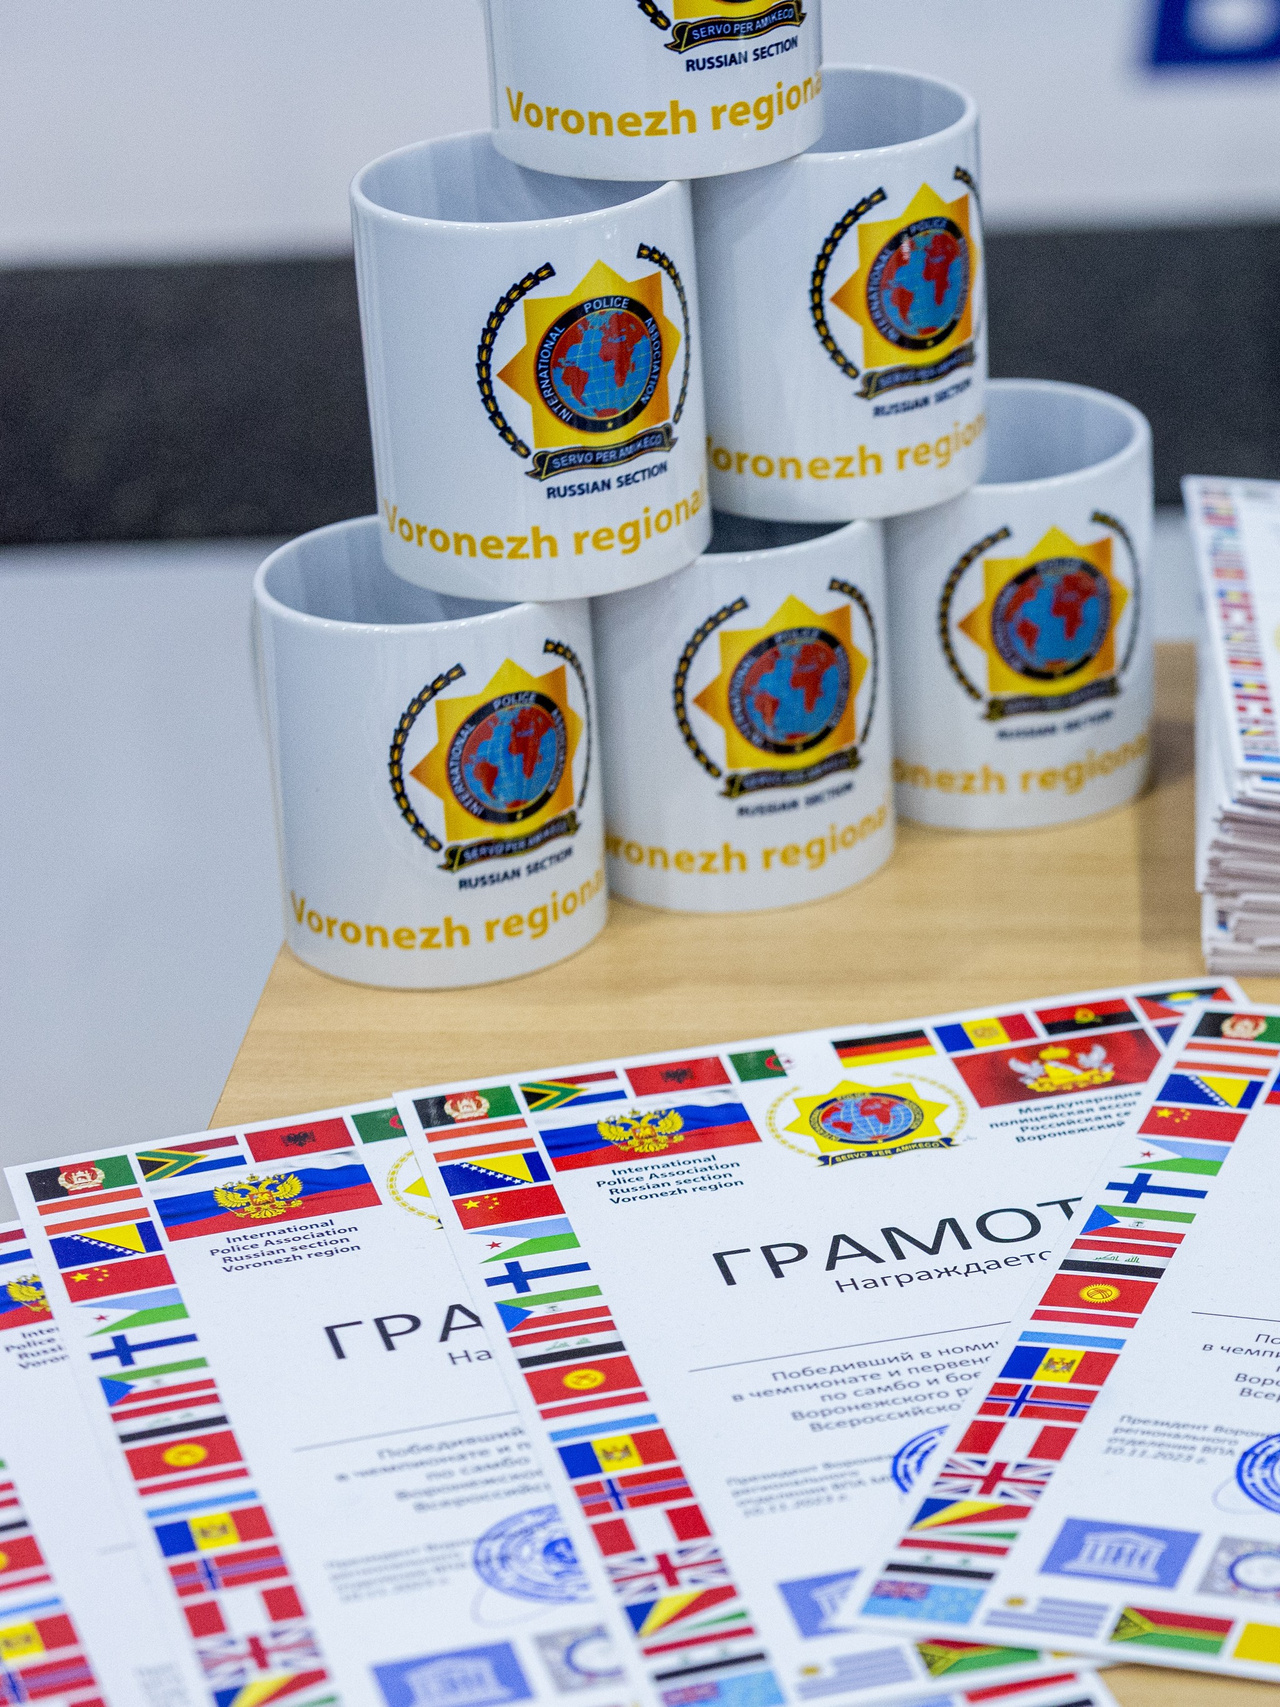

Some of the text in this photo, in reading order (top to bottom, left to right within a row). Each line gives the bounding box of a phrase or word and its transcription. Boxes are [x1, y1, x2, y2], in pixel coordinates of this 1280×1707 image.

[692, 8, 795, 40] SERVO PER AMIKECO
[686, 36, 798, 72] RUSSIAN SECTION
[506, 87, 696, 136] Voronezh
[537, 297, 661, 423] INTERNATIONAL POLICE ASSOCIATION
[552, 434, 662, 469] SERVO PER AMIKECO
[547, 461, 668, 499] RUSSIAN SECTION
[384, 498, 559, 560] Voronezh
[449, 693, 537, 816] INTERNATIONAL POLICE
[459, 846, 573, 890] RUSSIAN SECTION
[291, 890, 470, 949] Voronezh
[989, 1107, 1094, 1129] полицейская
[1015, 1121, 1125, 1143] Воронежский
[1020, 1114, 1111, 1132] Российская
[611, 1154, 717, 1176] International
[835, 1142, 939, 1162] SERVO PER AMIKECO
[596, 1161, 740, 1187] Police Association
[609, 1172, 733, 1195] Russian section
[610, 1180, 744, 1204] Voronezh region
[210, 1226, 358, 1256] Police Association
[226, 1219, 334, 1244] International
[222, 1244, 361, 1272] Voronezh region
[223, 1237, 350, 1263] Russian section
[5, 1338, 55, 1352] Police
[325, 1304, 484, 1359] ГРА
[448, 1349, 493, 1365] На
[771, 1341, 999, 1382] Победивший в номи
[731, 1394, 745, 1402] в
[749, 1372, 882, 1398] чемпионате
[888, 1369, 901, 1377] и
[820, 1393, 847, 1402] по
[853, 1380, 920, 1398] самбо
[927, 1378, 939, 1386] и
[791, 1387, 974, 1421] Воронежского р
[809, 1402, 961, 1433] Всероссийско
